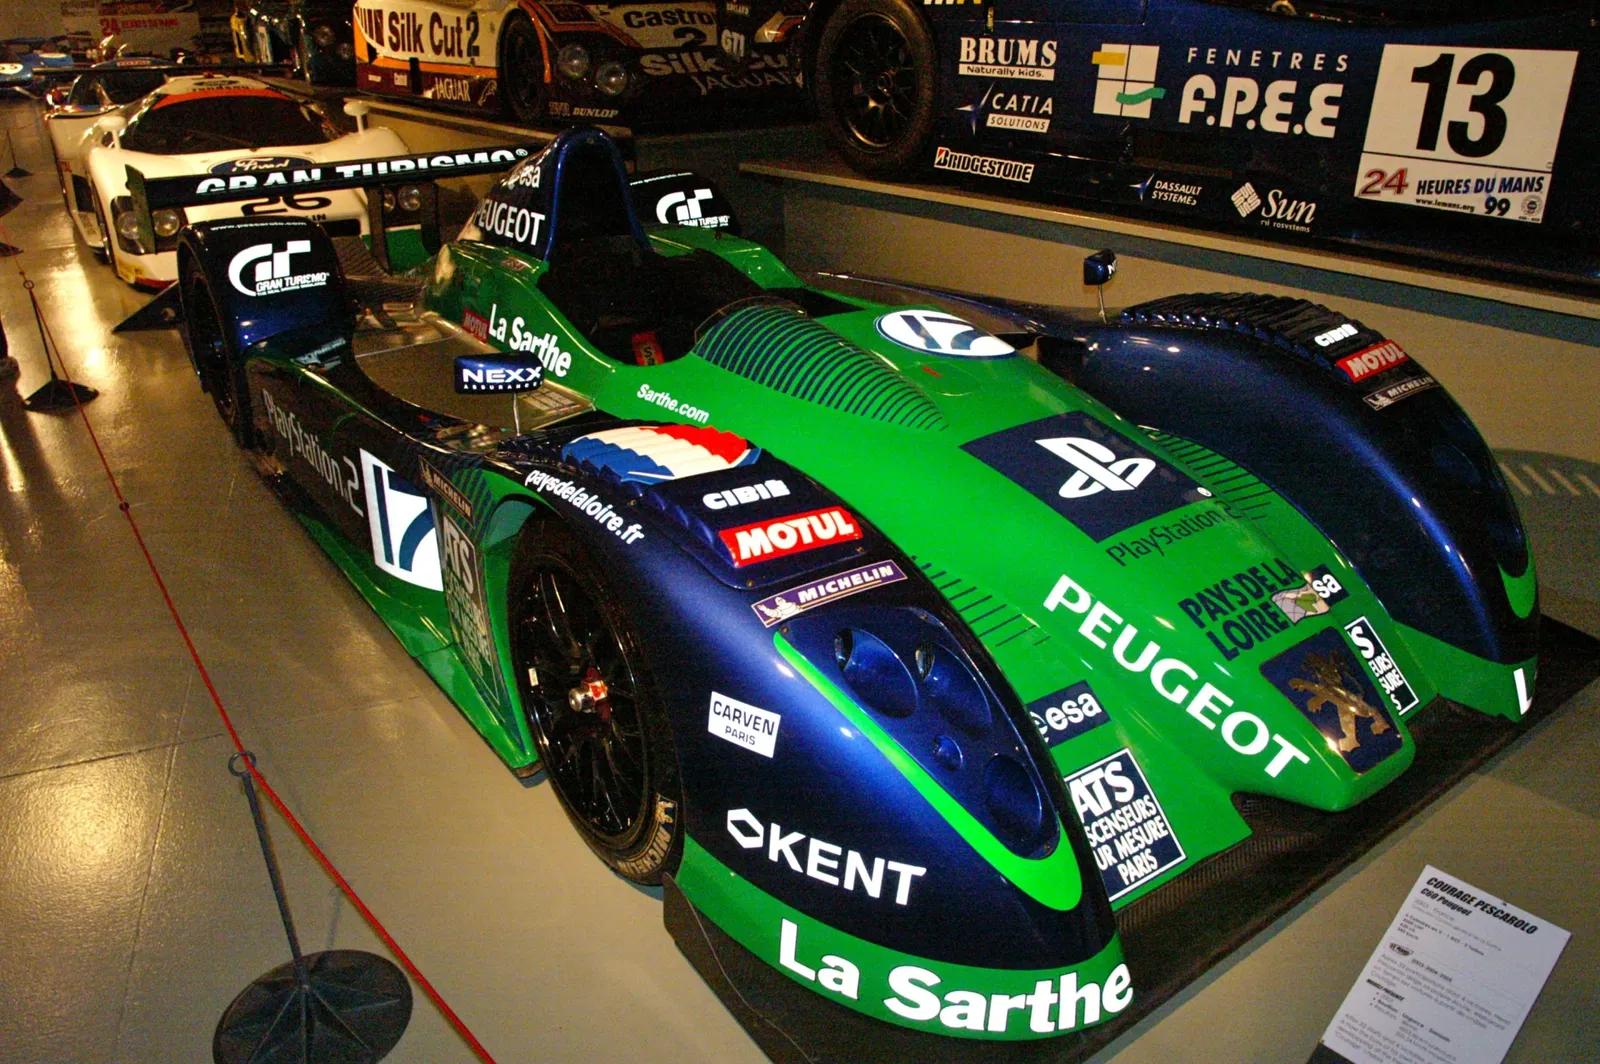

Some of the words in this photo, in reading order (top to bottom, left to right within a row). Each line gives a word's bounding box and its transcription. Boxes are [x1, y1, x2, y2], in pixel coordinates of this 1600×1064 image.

[388, 11, 425, 53] Silk
[429, 11, 464, 58] Cut
[466, 11, 480, 57] 2
[623, 8, 716, 28] Castro
[640, 51, 725, 76] Silk
[959, 36, 1058, 67] BRUMS
[1187, 47, 1349, 72] FENETRES
[434, 77, 471, 101] JAGUAR
[966, 65, 1016, 77] Naturally
[1018, 69, 1045, 78] kids.
[572, 107, 619, 119] DUNLOP
[990, 116, 1046, 130] SOLUTIONS
[992, 93, 1053, 115] CATIA
[1410, 52, 1516, 158] 13
[936, 148, 1032, 181] BRIDGESTONE
[1358, 167, 1410, 197] 24
[1416, 178, 1471, 196] HEURES
[1474, 177, 1497, 194] DU
[1499, 175, 1545, 193] MANS
[1154, 180, 1203, 196] DASSAULT
[1261, 189, 1317, 224] Sun
[1415, 198, 1476, 213] www.lemans.org
[1484, 196, 1512, 217] 99
[474, 198, 546, 246] PEUGEOT
[256, 278, 283, 293] GRAN
[488, 303, 508, 343] La
[508, 316, 572, 378] Sarthe
[462, 366, 542, 383] NEXX
[1345, 342, 1405, 378] MOTUL
[636, 383, 710, 424] Sarthe.com
[1387, 376, 1434, 398] MICHELIN
[262, 387, 344, 497] PlayStation
[342, 455, 364, 518] 2
[433, 472, 471, 518] MICHELIN
[524, 469, 646, 545] paysdelaloire.fr
[735, 510, 855, 560] MOTUL
[1105, 509, 1226, 567] PlayStation
[1214, 500, 1245, 519] 2
[443, 514, 475, 595] ATS
[798, 564, 895, 604] MICHELIN
[1178, 578, 1249, 629] PAYS
[1232, 562, 1273, 598] DE
[1260, 557, 1303, 586] LA
[1205, 602, 1290, 661] LOIRE
[1042, 574, 1311, 779] PEUGEOT
[713, 700, 775, 737] CARVEN
[724, 725, 756, 746] PARIS
[1069, 760, 1135, 824] ATS
[1086, 794, 1157, 848] SCENSEURS
[617, 825, 672, 875] MICHELIN
[1094, 849, 1117, 871] UR
[1116, 815, 1168, 862] MESURE
[767, 823, 927, 907] KENT
[1117, 850, 1158, 886] PARIS
[1426, 877, 1477, 905] COURAGE
[1474, 899, 1539, 935] PESCAROLO
[1436, 896, 1473, 917] Peugeot
[778, 918, 861, 1000] La
[882, 963, 1134, 1035] Sarthe
